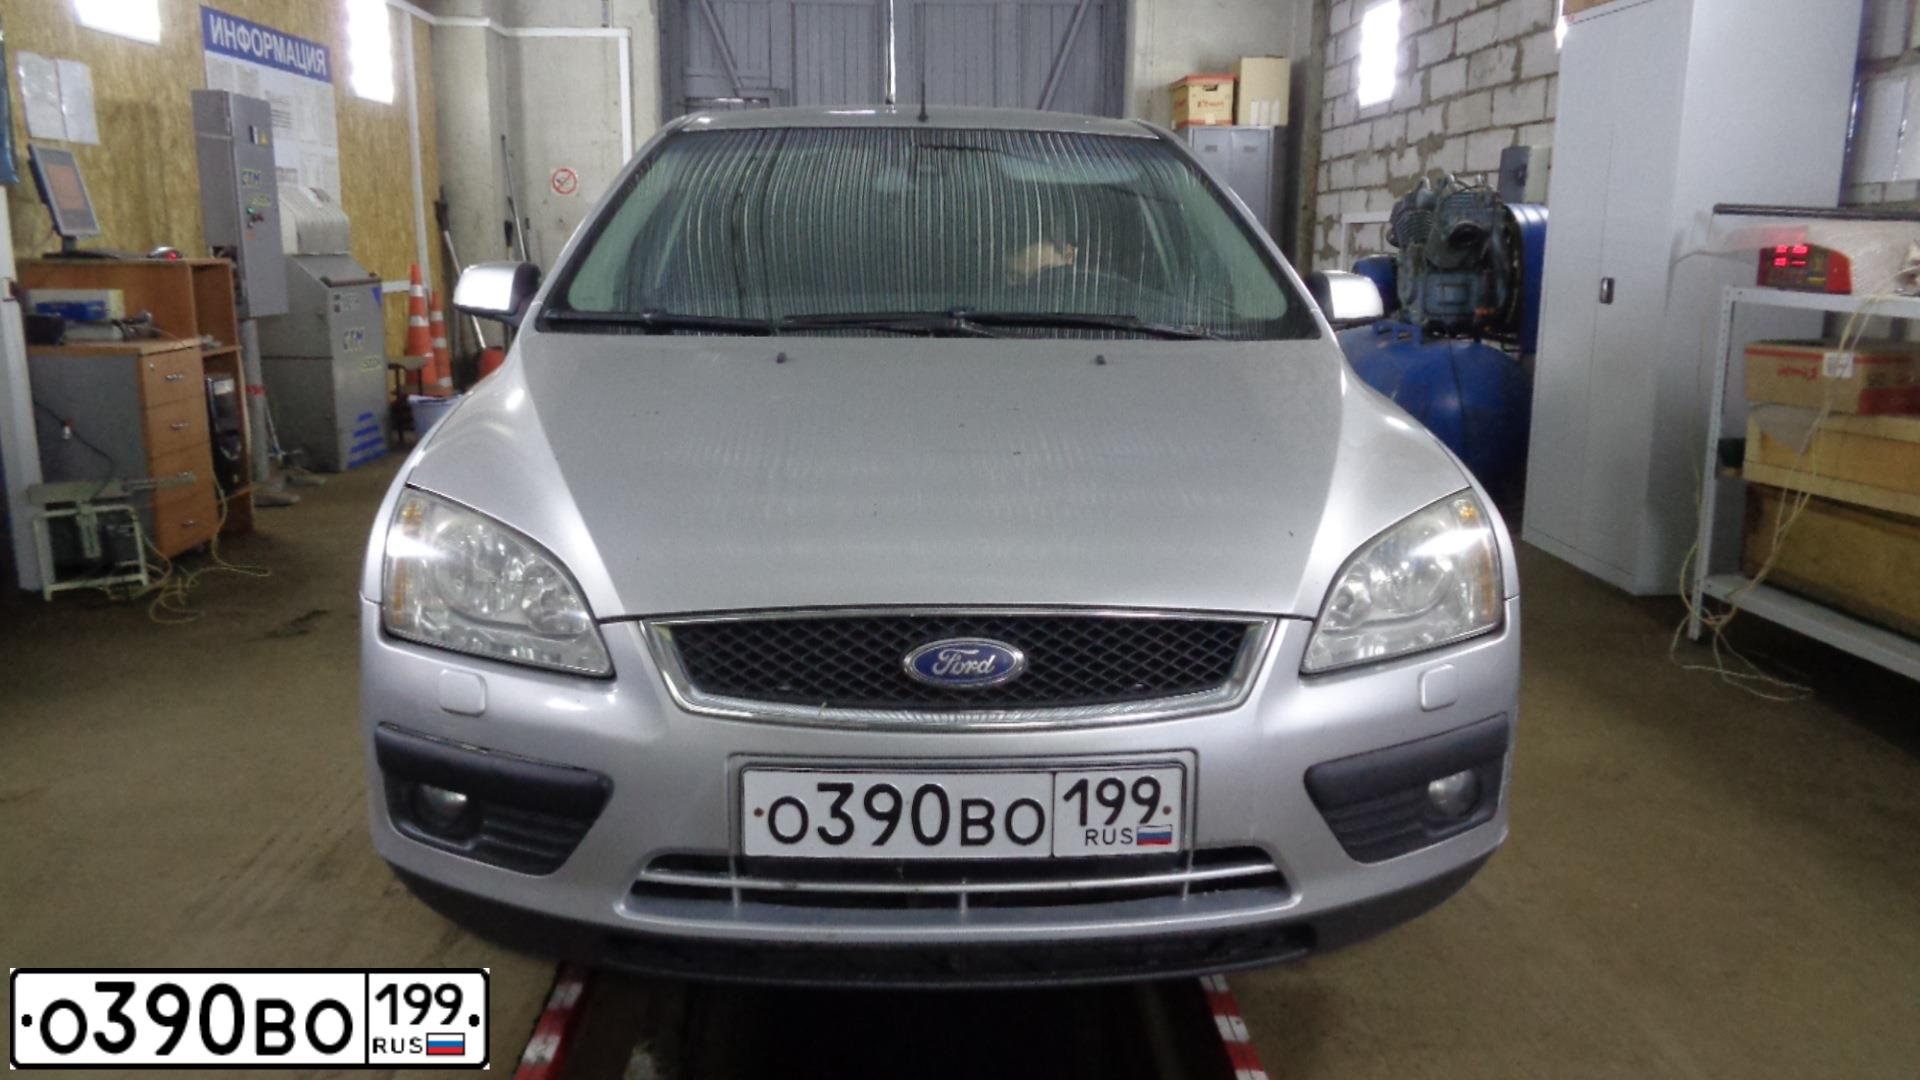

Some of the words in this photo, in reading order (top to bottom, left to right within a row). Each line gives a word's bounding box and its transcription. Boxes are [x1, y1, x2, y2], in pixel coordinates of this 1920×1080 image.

[208, 13, 327, 77] ИНФОРМАЦИЯ
[932, 648, 997, 676] Ford
[1063, 775, 1162, 827] 199
[1084, 827, 1134, 846] RUS
